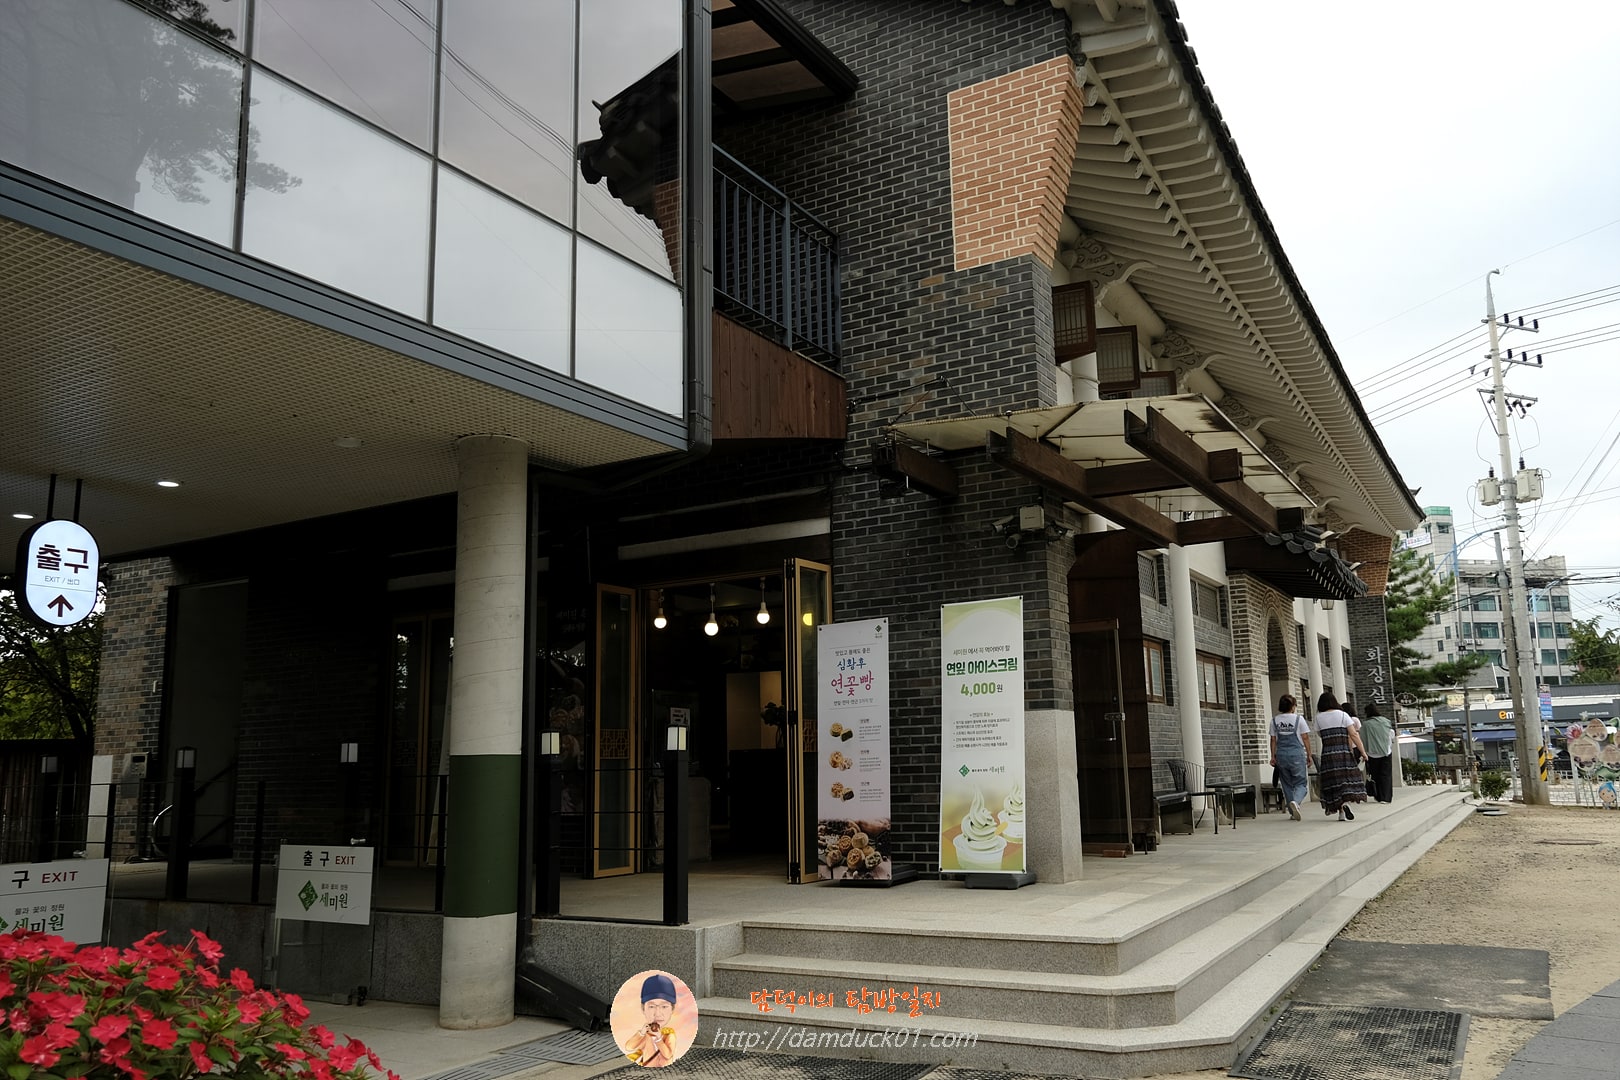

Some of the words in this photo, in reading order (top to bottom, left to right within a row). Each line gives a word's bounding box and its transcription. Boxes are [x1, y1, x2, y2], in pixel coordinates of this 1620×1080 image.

[36, 543, 89, 574] 출구
[44, 575, 60, 584] EXIT
[66, 578, 80, 586] 出口
[837, 657, 867, 671] 심황후
[946, 661, 966, 677] 연잎
[967, 657, 1018, 674] 아이스크림
[831, 670, 874, 696] 연꽃빵
[1365, 645, 1388, 704] 화장실
[335, 855, 356, 866] EXIT
[41, 871, 79, 884] EXIT
[50, 903, 65, 912] 정원
[319, 892, 348, 912] 세미원
